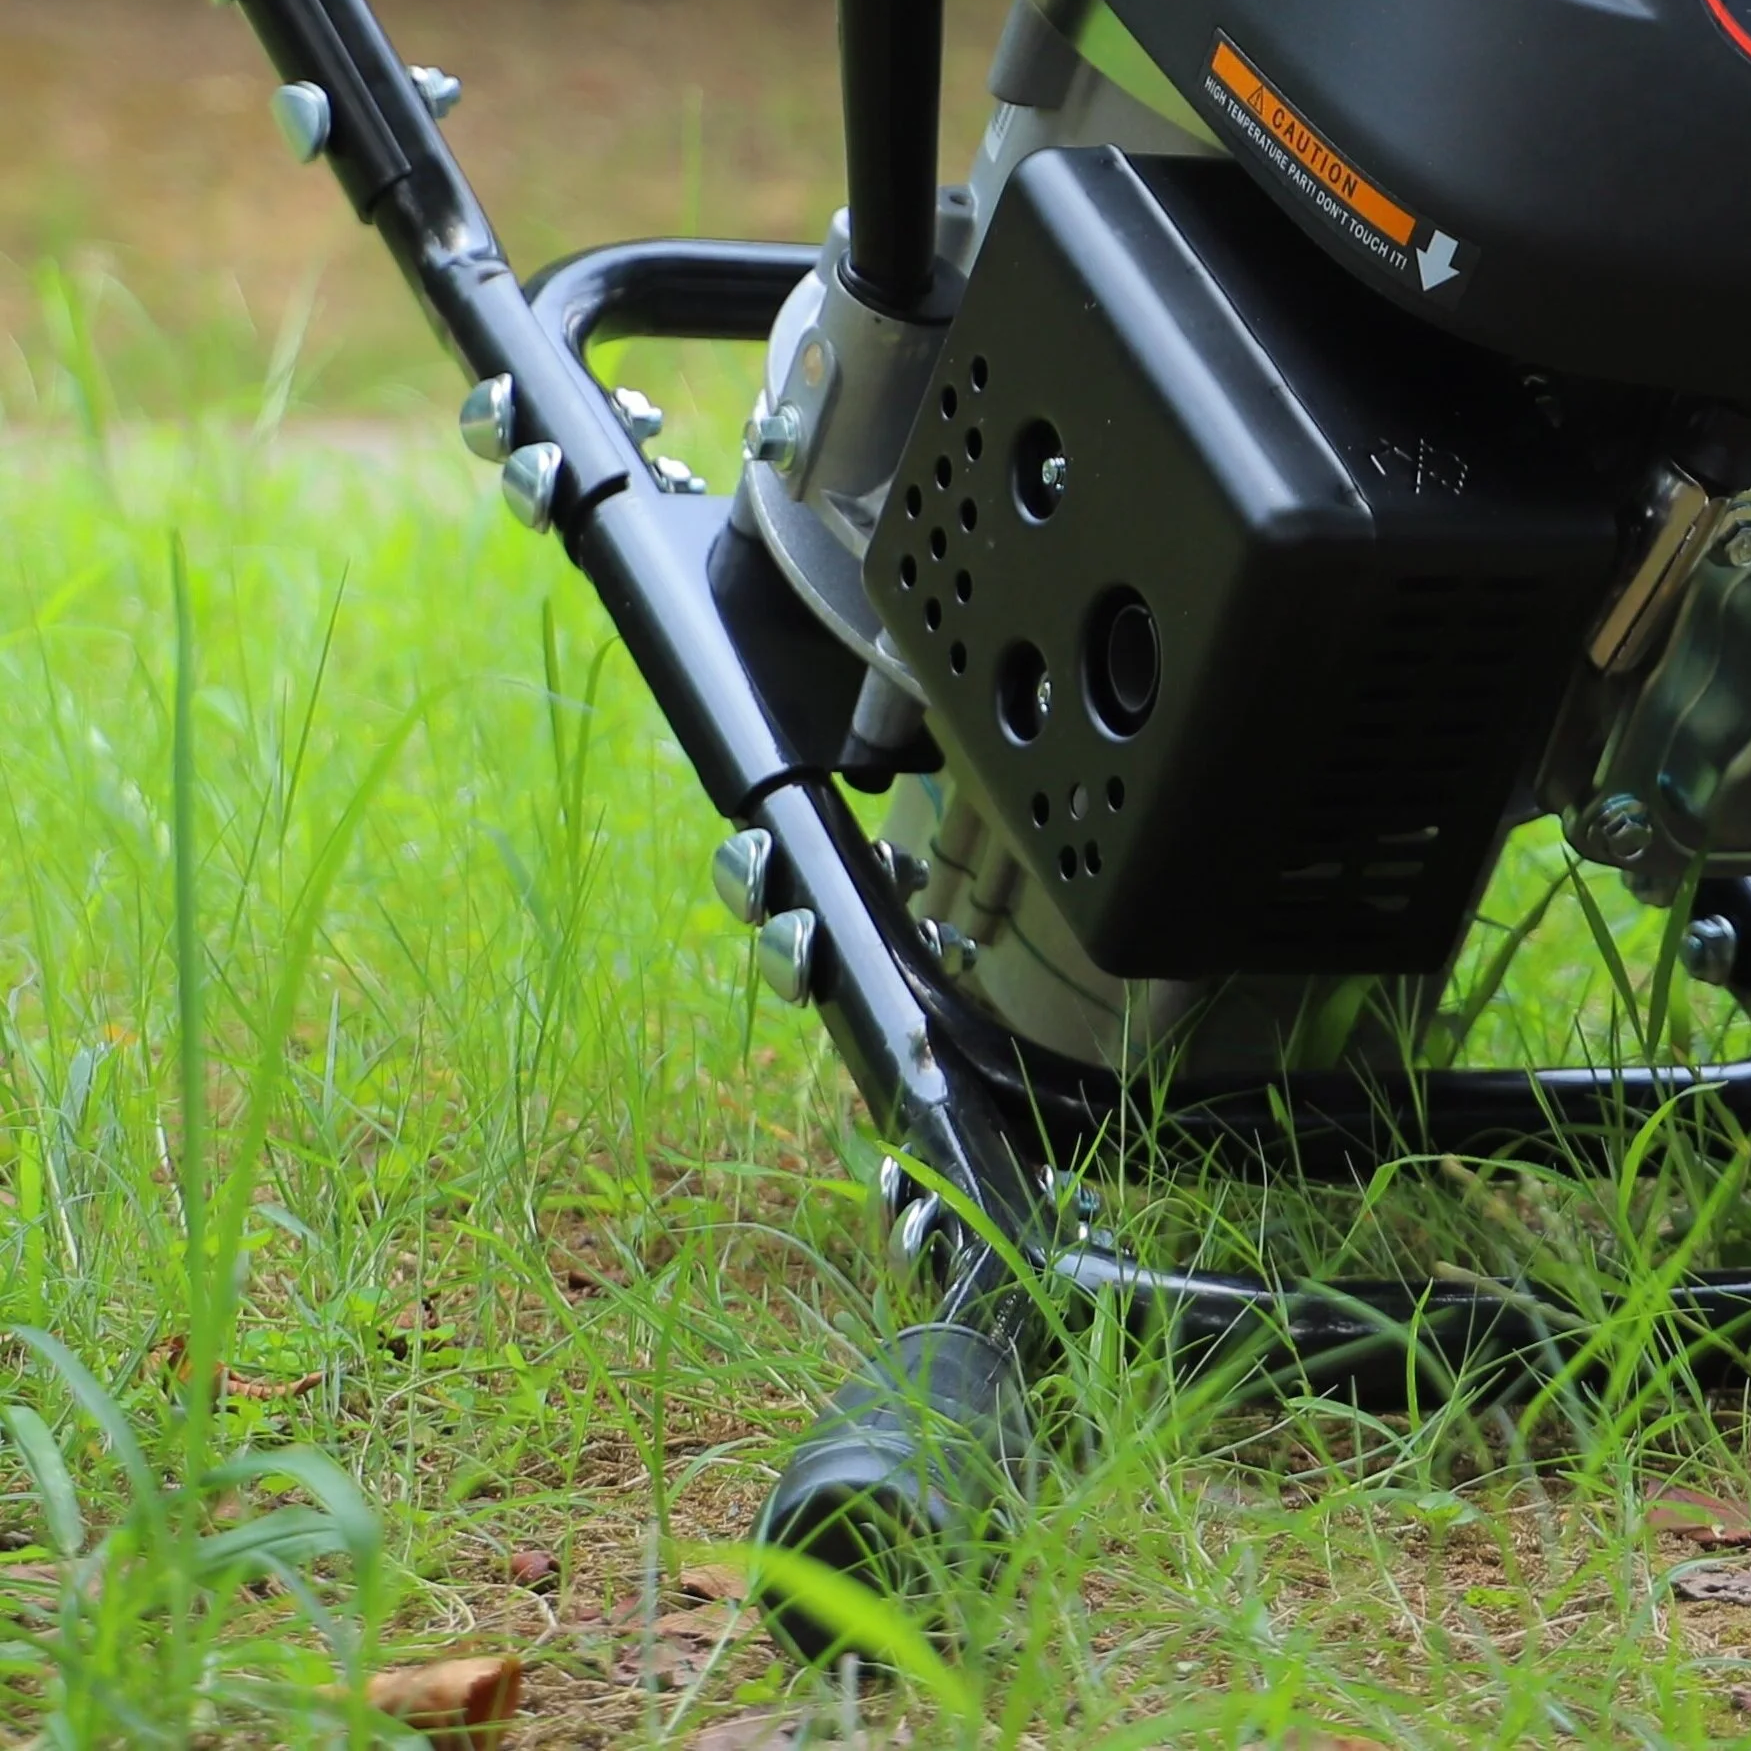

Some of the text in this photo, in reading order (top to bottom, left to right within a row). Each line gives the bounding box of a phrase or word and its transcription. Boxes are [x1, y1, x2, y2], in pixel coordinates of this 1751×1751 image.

[1204, 76, 1226, 106] HIGH
[1227, 98, 1288, 171] TEMPERATURE
[1315, 191, 1349, 226] DON'T
[1349, 218, 1389, 258] TOUCH
[1271, 107, 1358, 199] CAUTION
